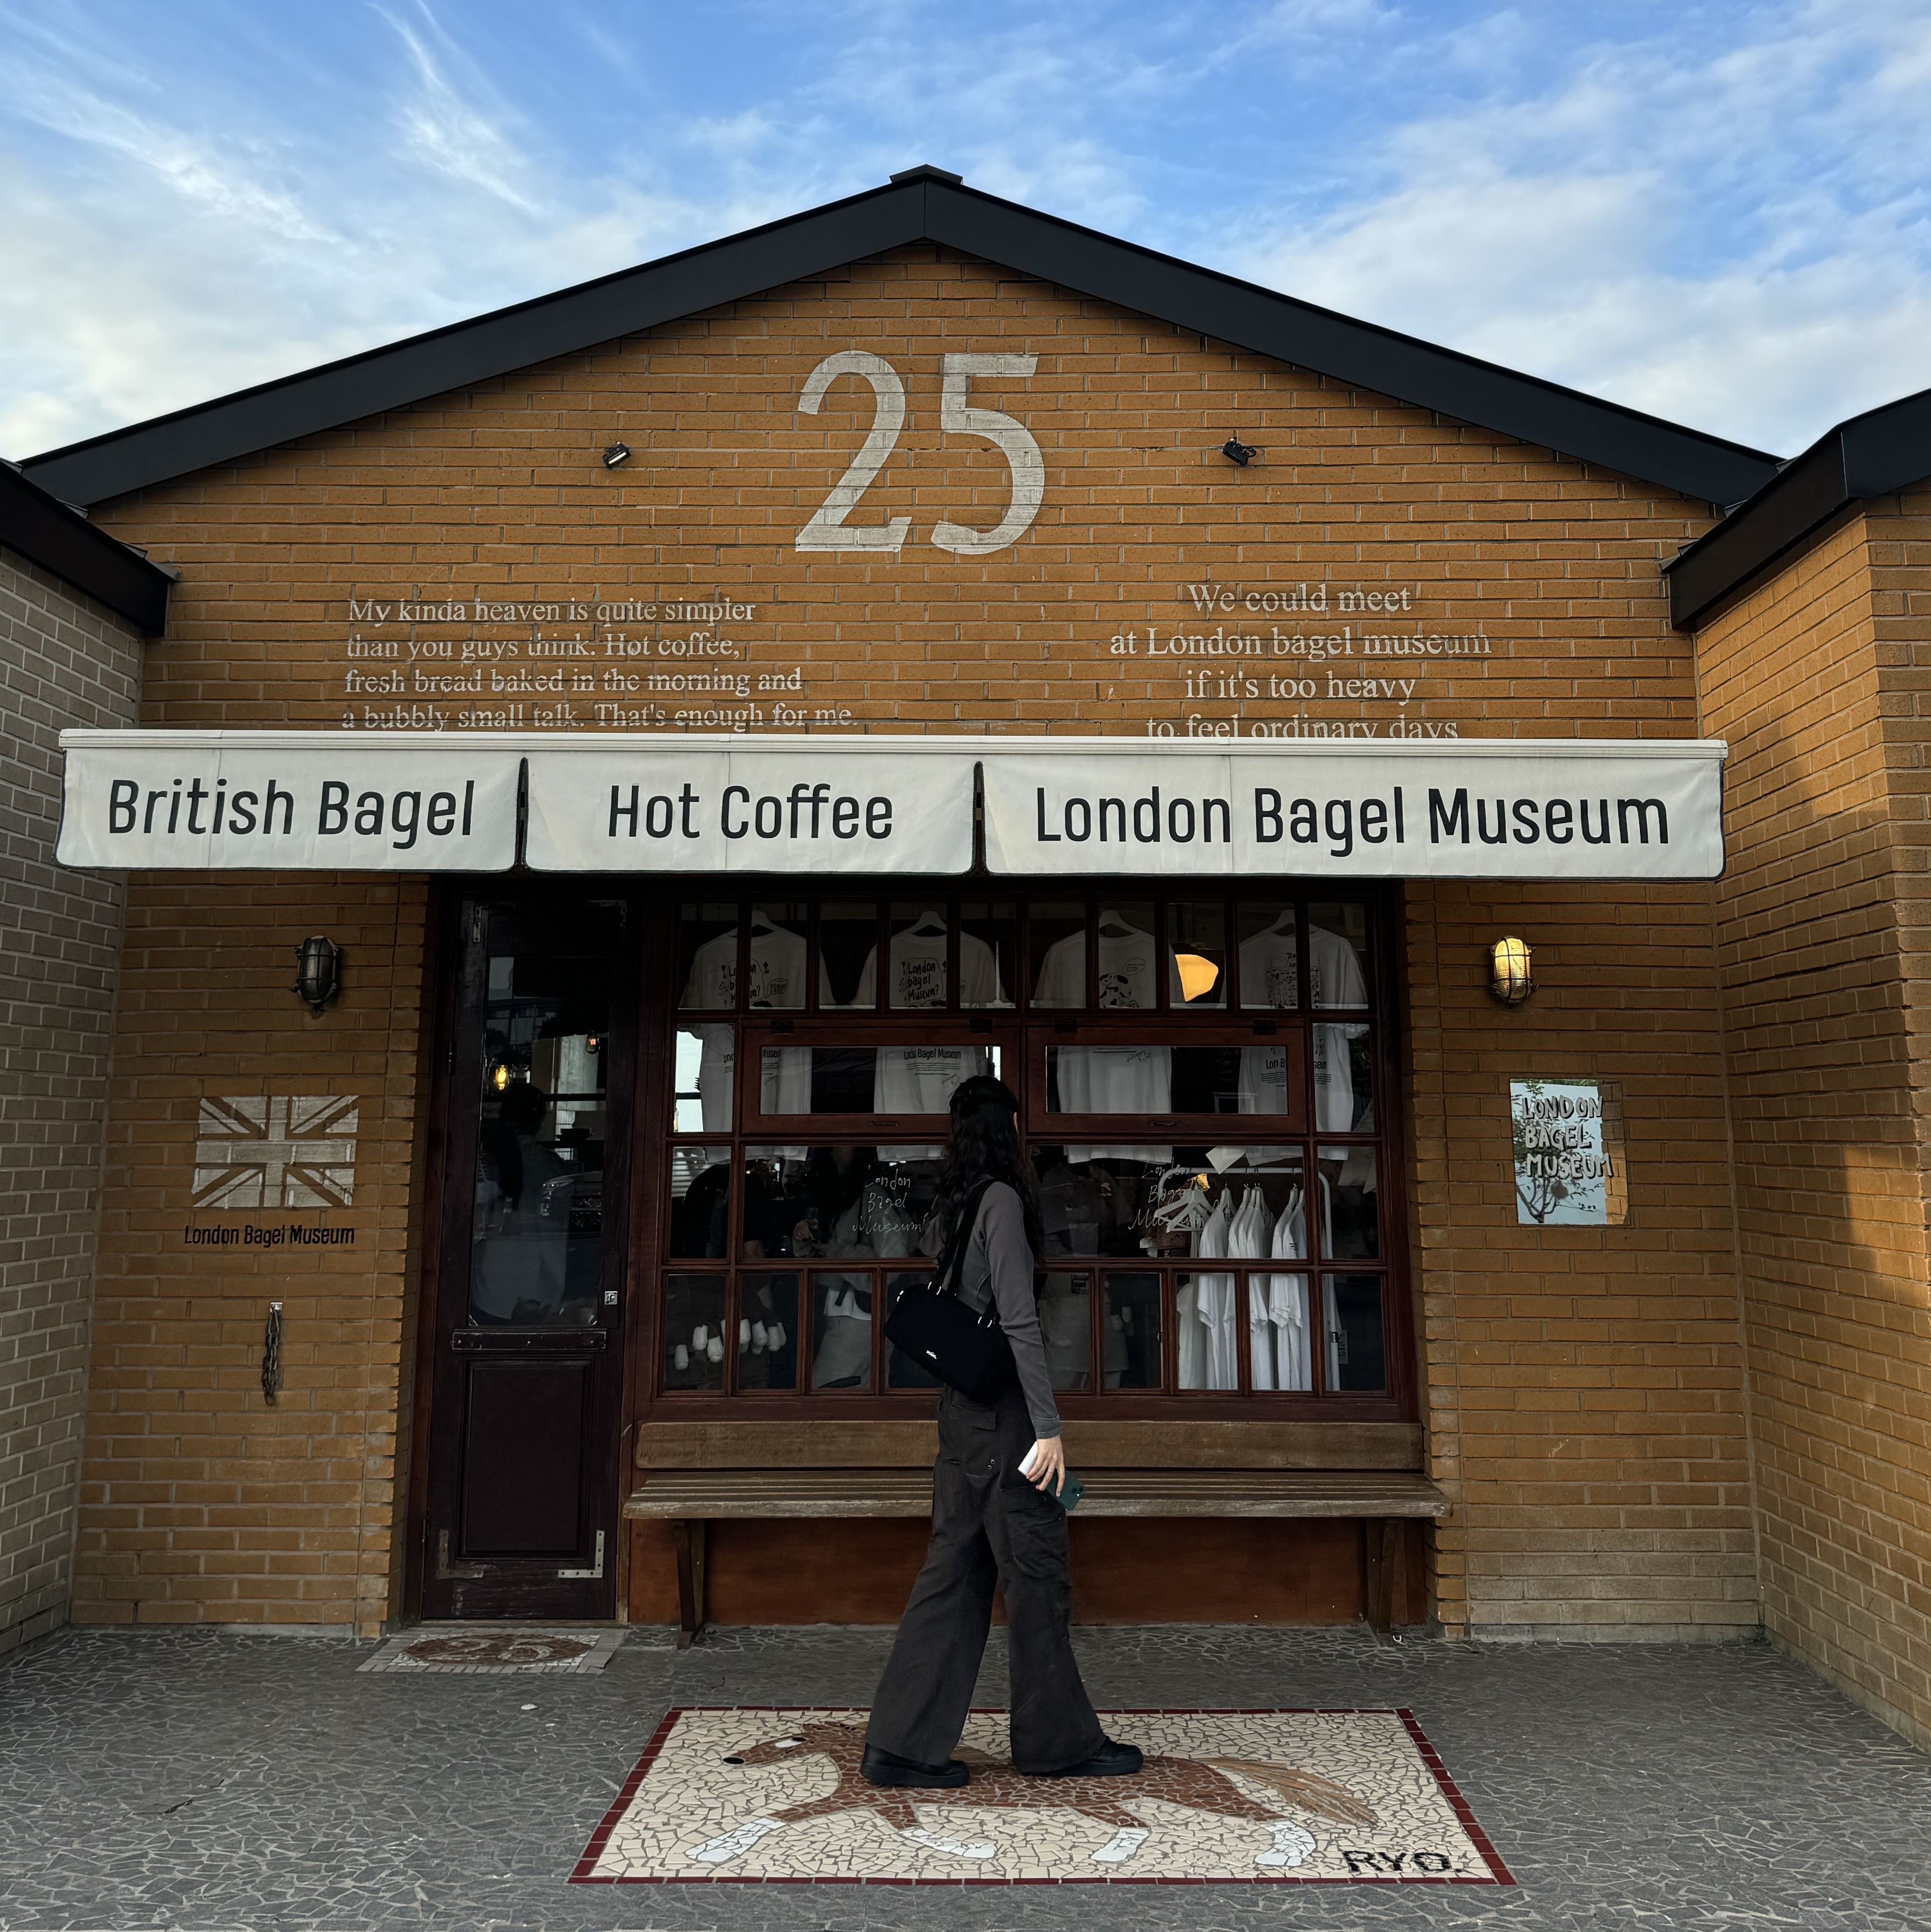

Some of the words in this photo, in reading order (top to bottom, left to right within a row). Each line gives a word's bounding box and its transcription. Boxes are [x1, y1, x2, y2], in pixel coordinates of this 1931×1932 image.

[795, 350, 1045, 555] 25
[1188, 585, 1235, 611] We
[1246, 583, 1329, 611] could
[1337, 587, 1412, 611] meet
[349, 599, 391, 626] My
[397, 598, 466, 621] kinda
[475, 597, 559, 621] heaven
[569, 598, 587, 620] is
[597, 598, 656, 627] quite
[665, 597, 756, 626] simpler
[347, 633, 399, 656] than
[408, 641, 453, 662] you
[462, 640, 518, 662] guys
[528, 633, 596, 656] think.
[605, 633, 651, 656] Hot
[658, 632, 739, 659] coffee,
[1110, 631, 1137, 654] at
[1147, 626, 1263, 655] London
[1271, 626, 1353, 662] bagel
[1362, 634, 1491, 655] museum
[344, 670, 405, 693] fresh
[415, 669, 482, 692] bread
[491, 669, 563, 692] baked
[571, 668, 595, 691] in
[603, 668, 639, 691] the
[647, 667, 751, 697] morning
[758, 667, 803, 690] and
[1186, 670, 1212, 698] if
[1218, 670, 1259, 698] it's
[1269, 674, 1316, 698] too
[1326, 670, 1416, 706] heavy
[342, 711, 354, 728] a
[364, 705, 450, 731] bubbly
[459, 704, 524, 728] small
[533, 704, 584, 727] talk.
[595, 704, 665, 726] That's
[674, 703, 764, 732] enough
[773, 702, 807, 726] for
[815, 708, 858, 725] me.
[1147, 717, 1175, 737] to
[1186, 713, 1238, 737] feel
[1251, 714, 1378, 737] ordinary
[1389, 714, 1458, 738] days
[108, 778, 294, 835] British
[318, 780, 474, 849] Bagel
[608, 782, 700, 839] Hot
[720, 782, 893, 839] Coffee
[1036, 787, 1232, 844] London
[1254, 786, 1405, 858] Bagel
[1428, 788, 1670, 845] Museum
[908, 959, 936, 974] London
[918, 1048, 936, 1060] Bagel
[1522, 1095, 1603, 1119] LONDON
[1525, 1123, 1592, 1150] BAGEL
[864, 1165, 910, 1190] London
[1527, 1152, 1614, 1179] MUSEUM
[868, 1193, 906, 1214] Bagel
[184, 1225, 239, 1244] London
[244, 1225, 285, 1248] Bagel
[290, 1225, 355, 1244] Museum
[853, 1216, 922, 1234] Museum
